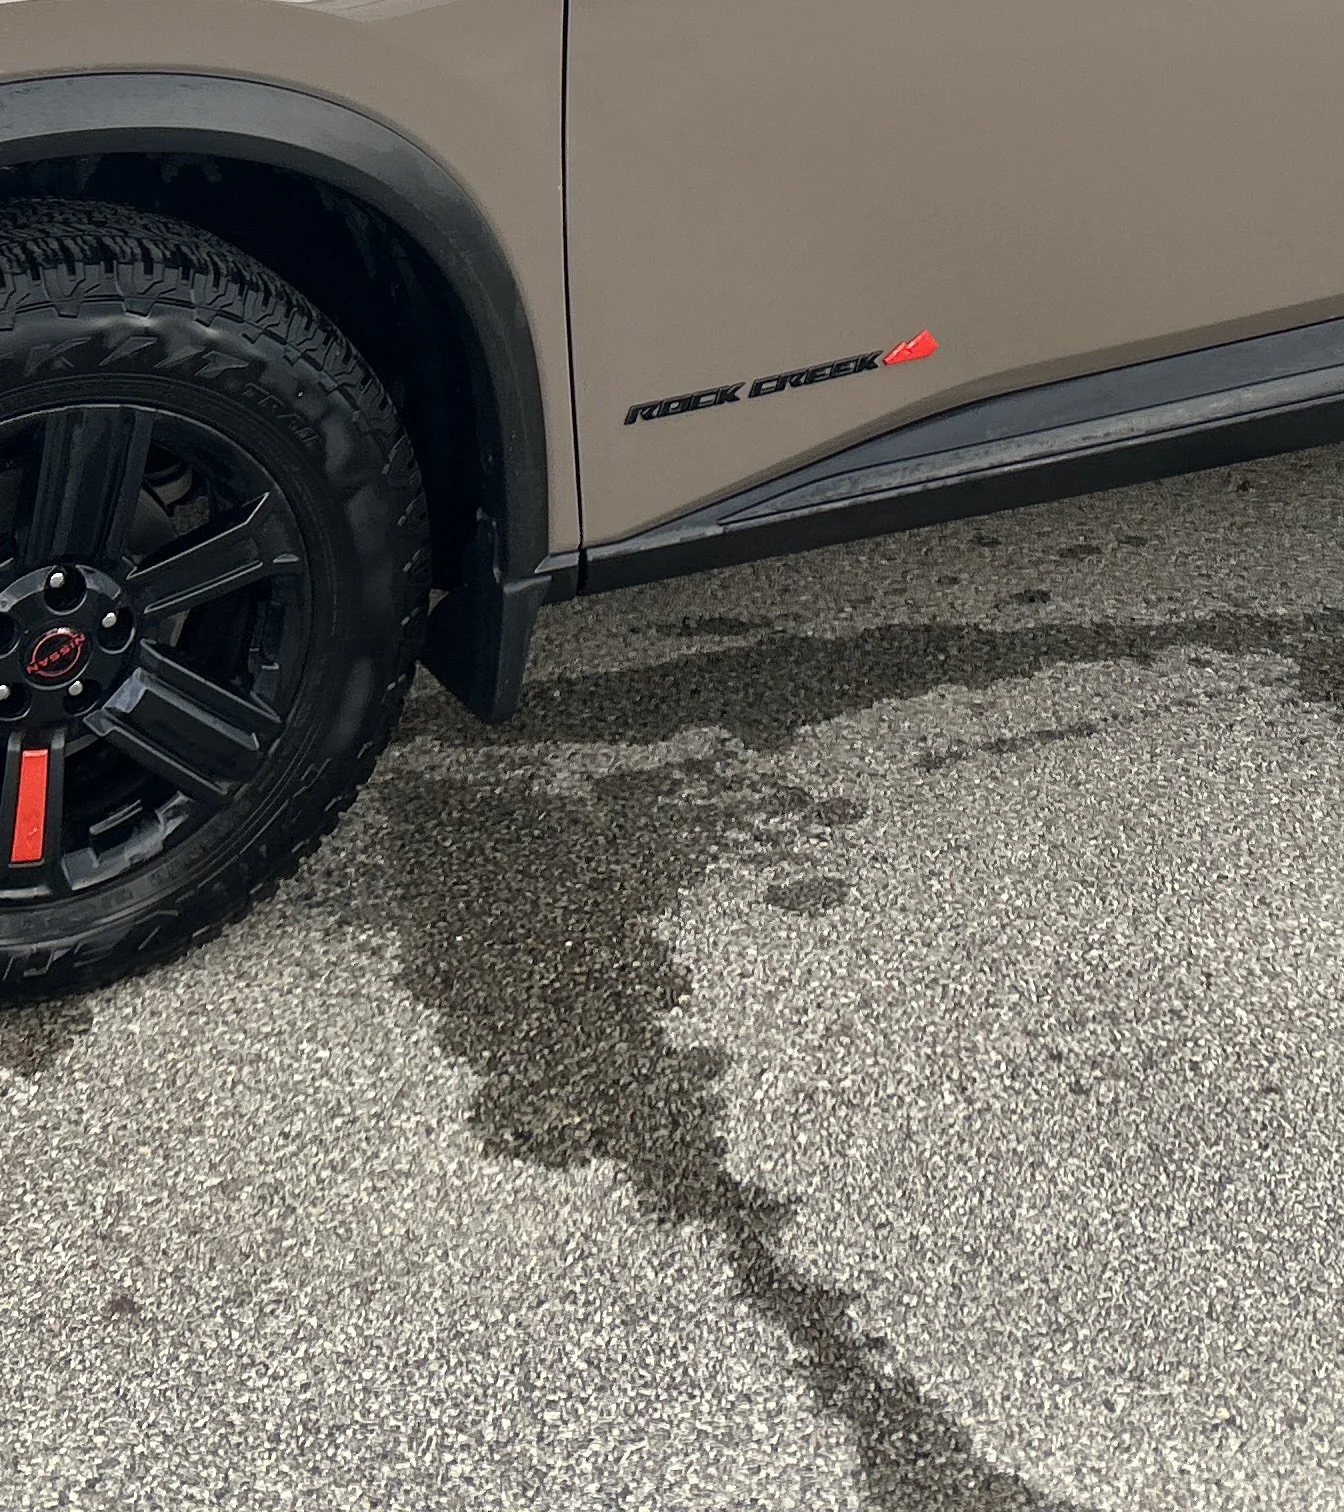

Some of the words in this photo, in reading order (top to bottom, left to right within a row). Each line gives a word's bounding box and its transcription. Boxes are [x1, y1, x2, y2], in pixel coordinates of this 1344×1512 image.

[623, 381, 746, 426] ROCK
[747, 349, 885, 399] CREEK
[25, 631, 87, 676] NISSAN
